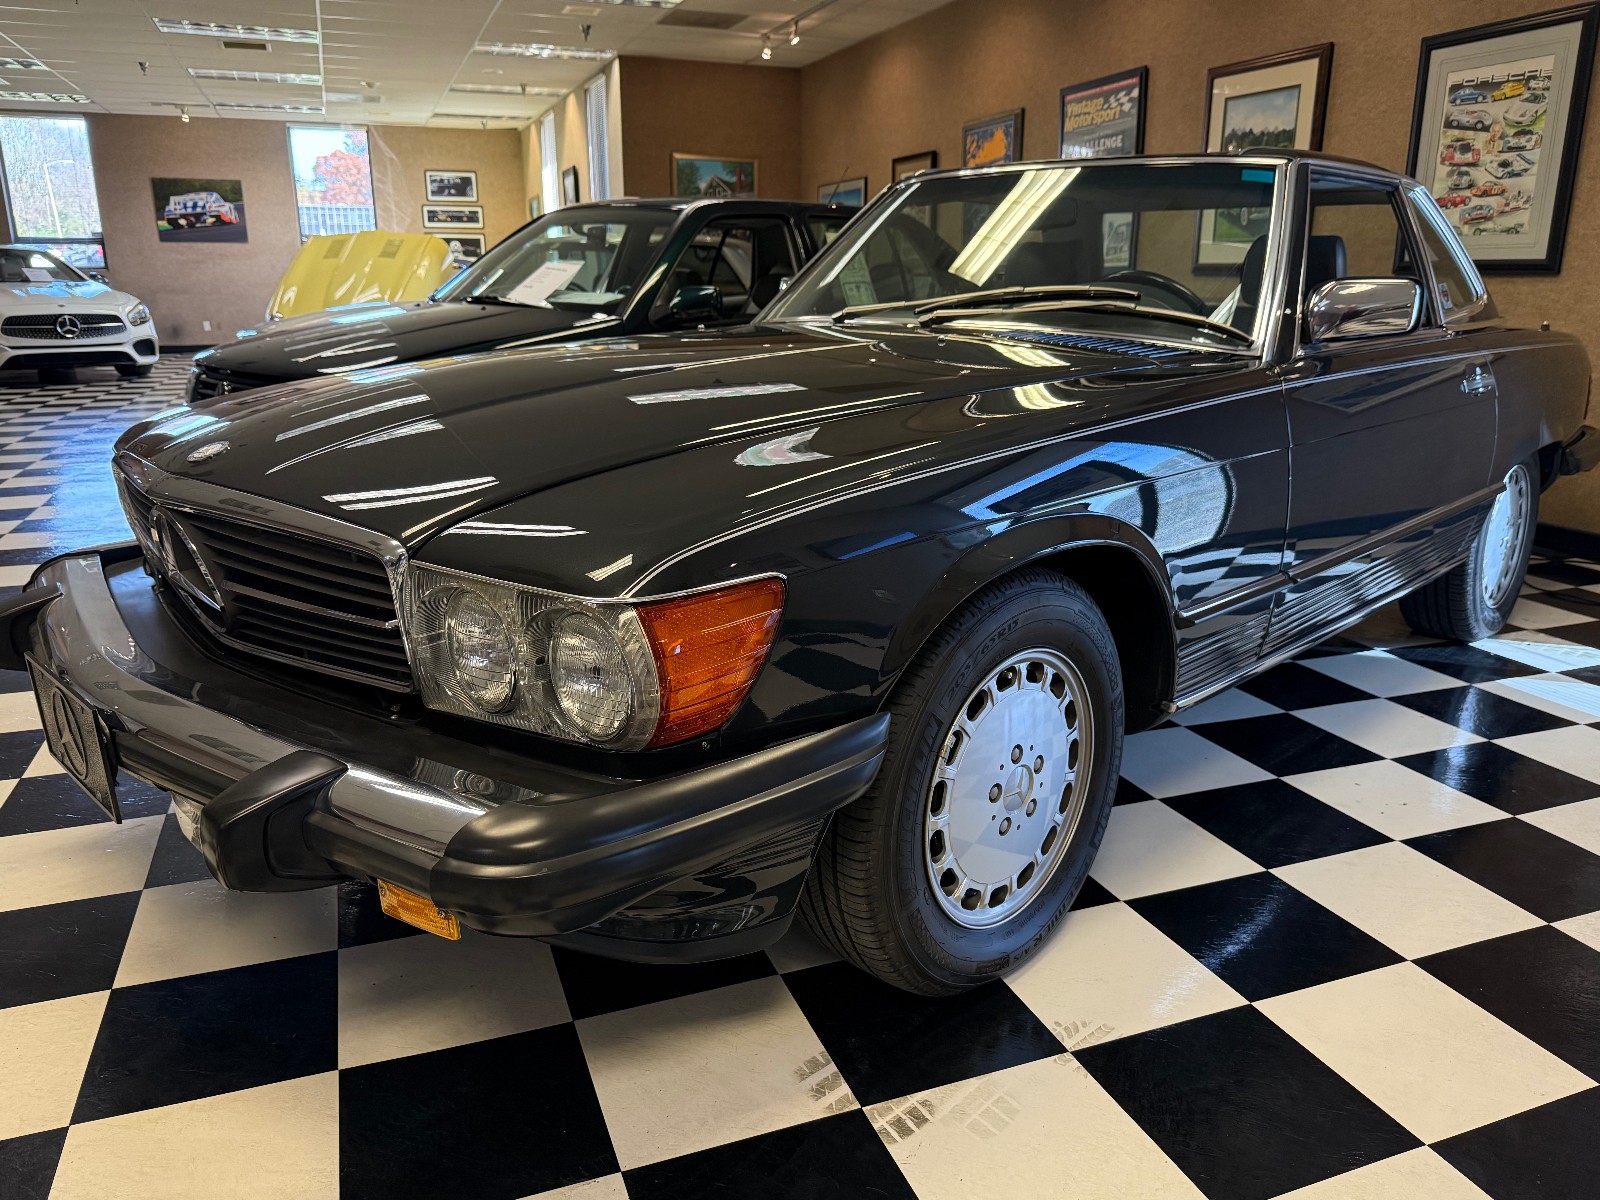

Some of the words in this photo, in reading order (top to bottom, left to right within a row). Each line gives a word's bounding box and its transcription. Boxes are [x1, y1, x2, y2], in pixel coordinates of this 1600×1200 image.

[1449, 68, 1553, 87] PORSCHE
[1067, 97, 1104, 114] Vintage
[1064, 105, 1121, 132] Motorsport
